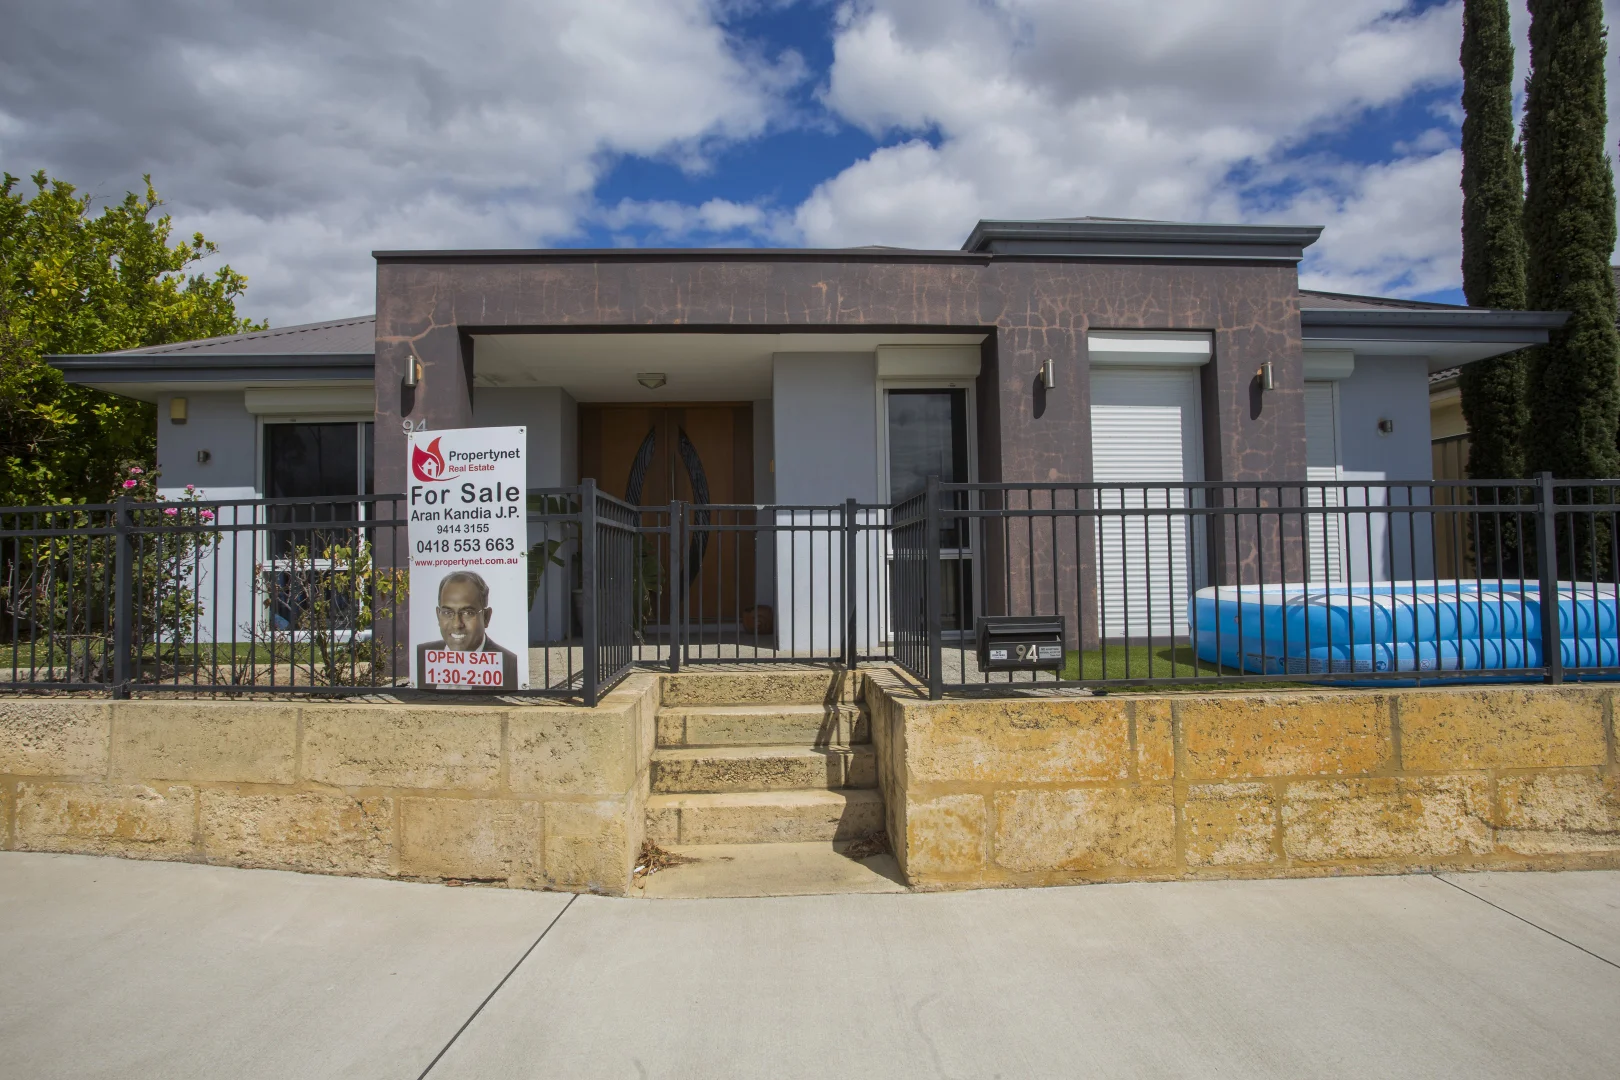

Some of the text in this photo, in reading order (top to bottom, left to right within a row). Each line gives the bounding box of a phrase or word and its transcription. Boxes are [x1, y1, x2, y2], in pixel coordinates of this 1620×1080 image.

[402, 418, 427, 435] 94
[449, 448, 520, 462] Propertynet
[449, 463, 495, 472] Real Estate
[411, 482, 520, 505] For Sale
[411, 506, 519, 521] Aran Kandia J.P.
[437, 523, 489, 534] 9414 3155
[417, 538, 514, 553] 0418 553 663
[415, 558, 518, 567] www.propertynet.com.au
[427, 651, 499, 665] OPEN SAT.
[1015, 644, 1038, 662] 94
[428, 668, 502, 685] 1:30-2:00
